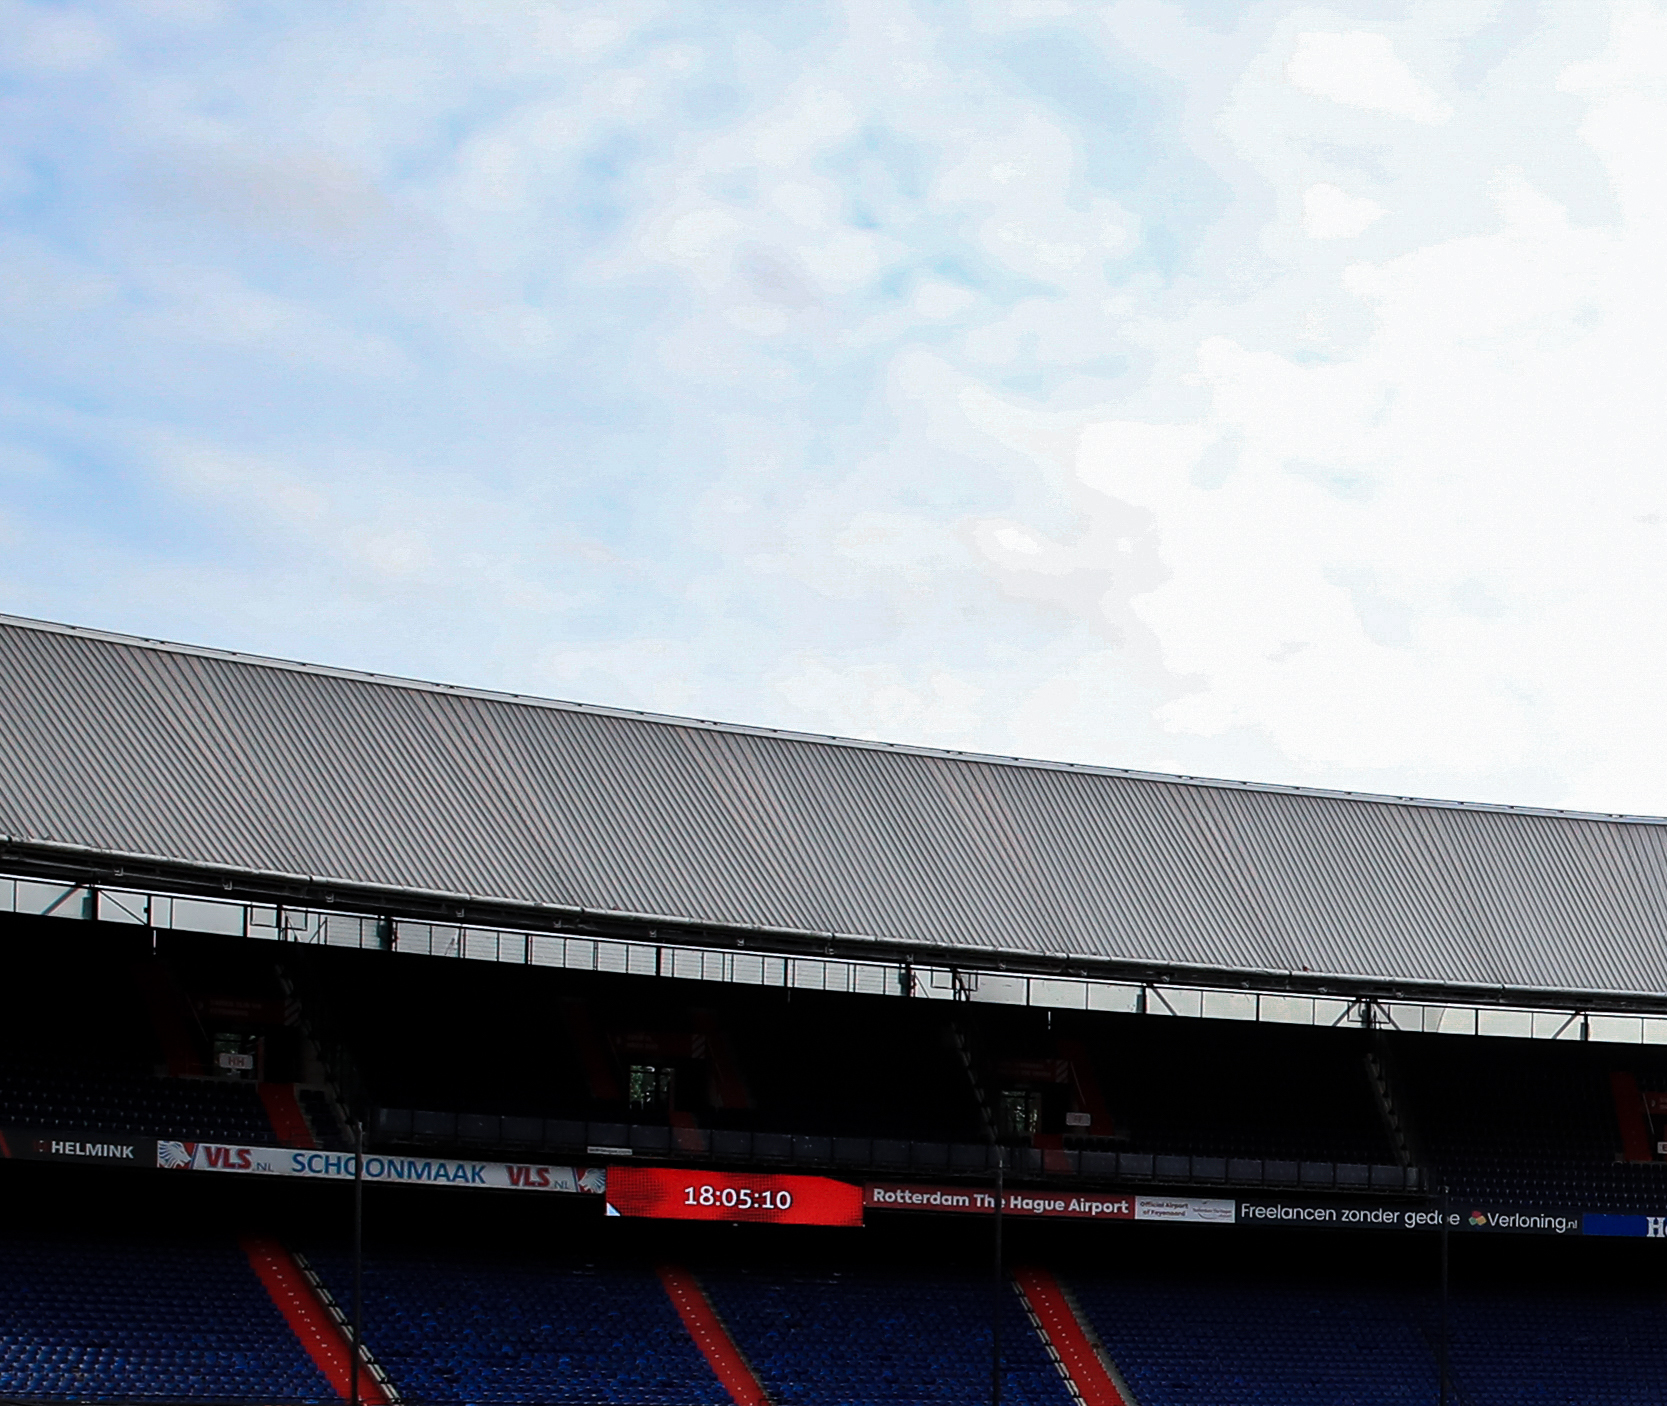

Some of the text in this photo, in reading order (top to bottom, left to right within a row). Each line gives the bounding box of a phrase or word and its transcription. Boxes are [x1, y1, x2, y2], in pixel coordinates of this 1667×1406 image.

[51, 1140, 134, 1159] HELMINK
[204, 1146, 251, 1168] VLS
[292, 1153, 486, 1184] SCHOONMAAK
[506, 1165, 550, 1187] VLS
[684, 1185, 792, 1209] 18:05:10
[873, 1188, 1129, 1217] Rotterdam The Hague Airport
[1241, 1203, 1336, 1222] Freelancen
[1341, 1208, 1400, 1225] zonder
